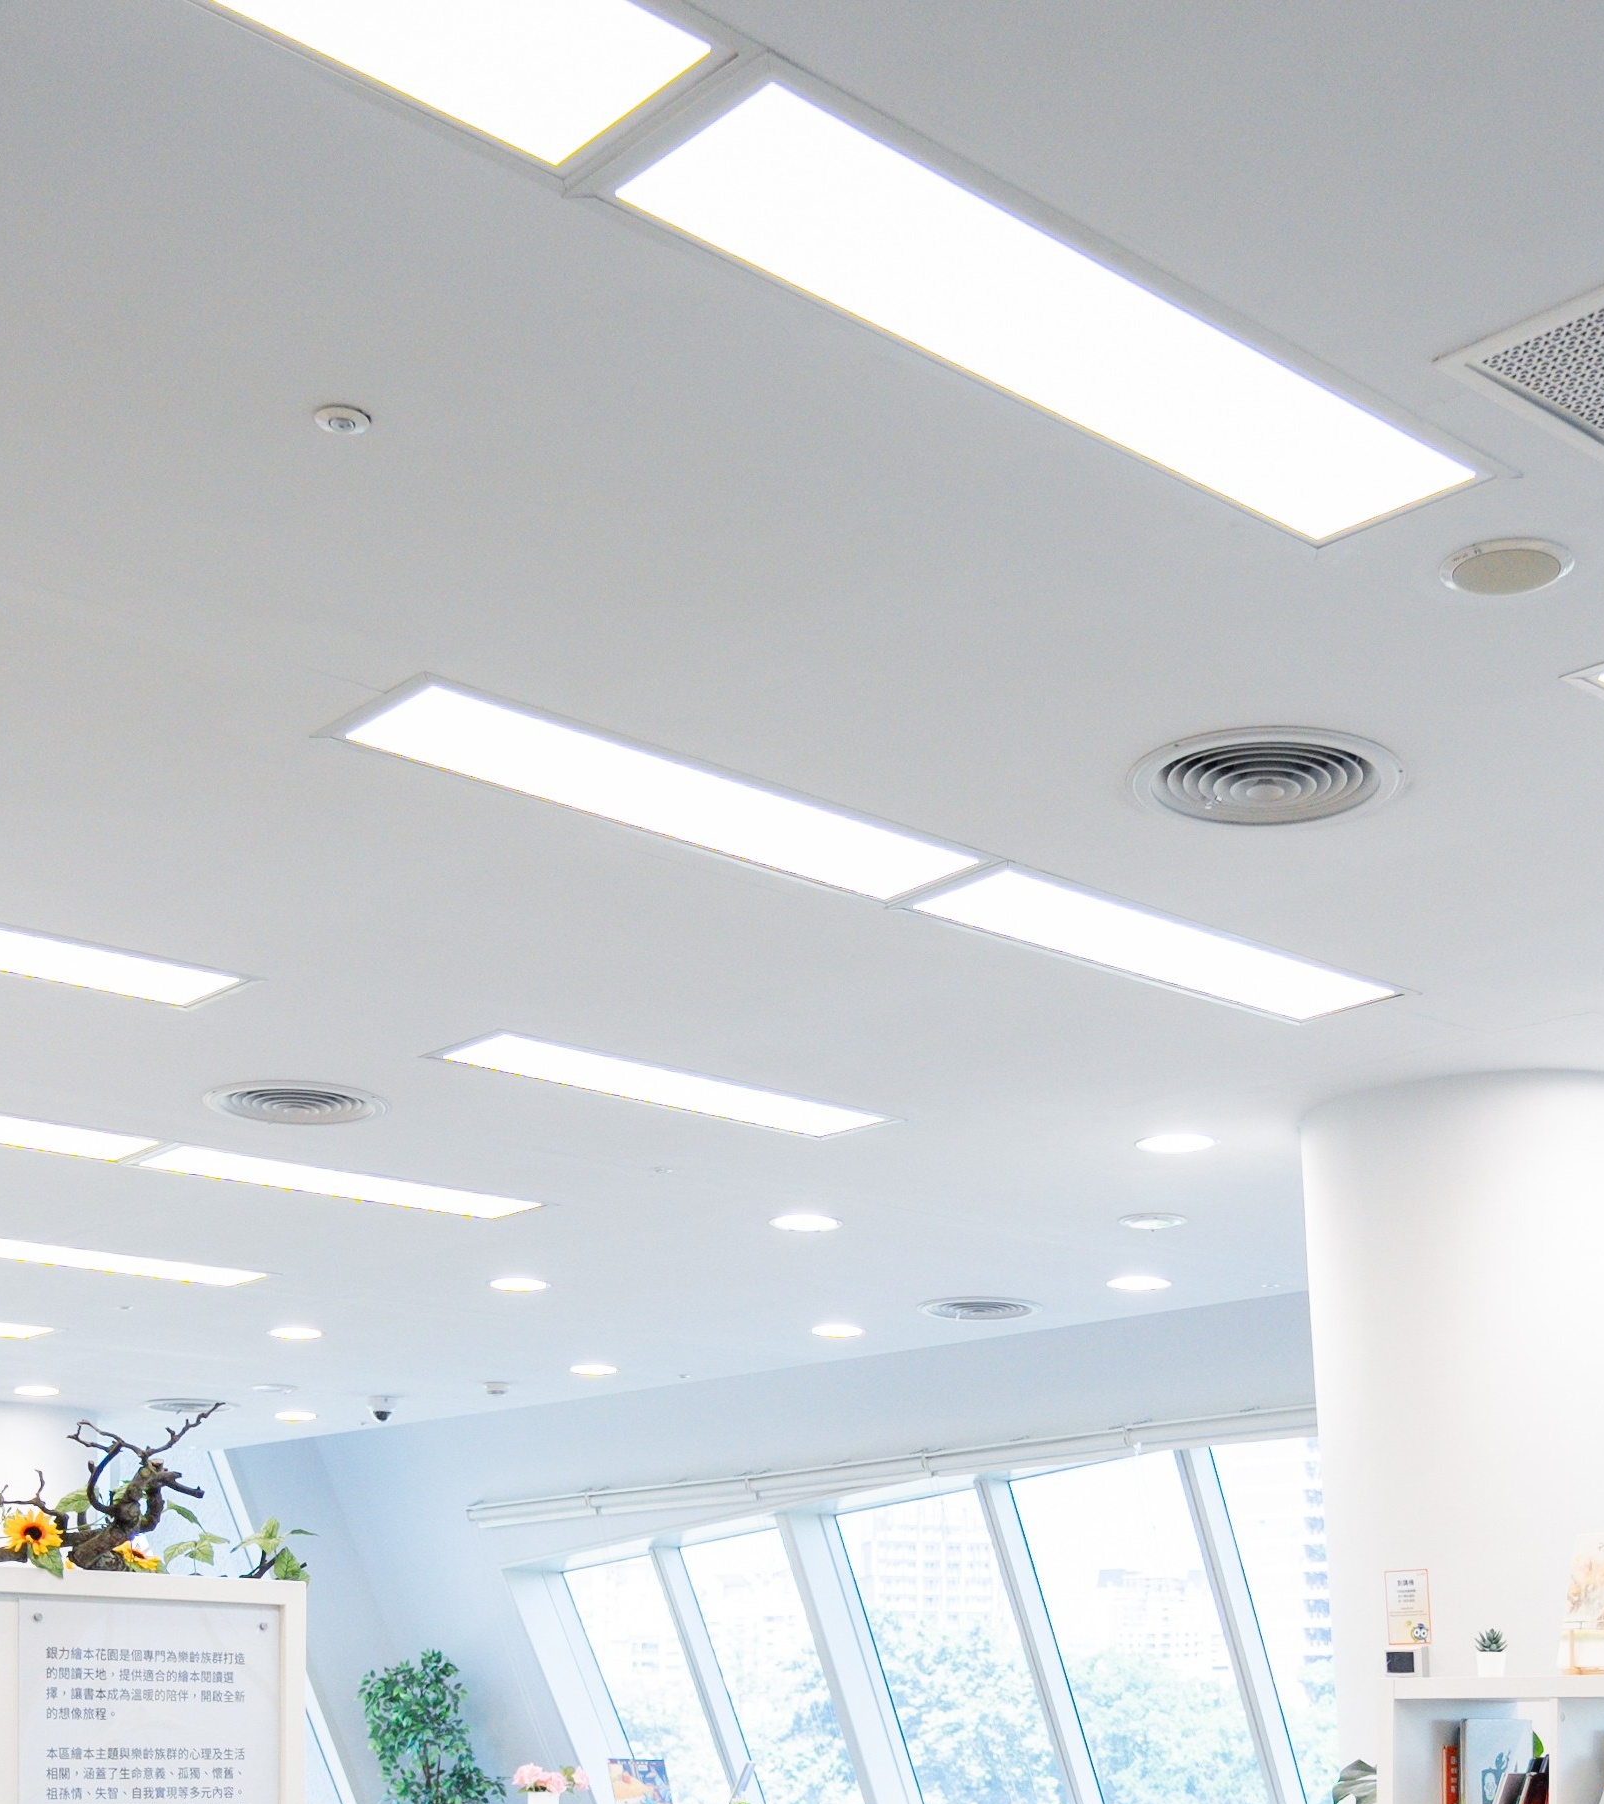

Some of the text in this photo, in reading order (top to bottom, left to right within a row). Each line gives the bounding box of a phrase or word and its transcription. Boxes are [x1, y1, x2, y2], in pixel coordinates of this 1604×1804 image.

[46, 1647, 245, 1665] 銀力繪本花園是個專門為樂齡族群打造
[46, 1707, 116, 1721] 的想像旅程。
[46, 1747, 245, 1761] 本區繪本主題與樂齡族群的心理及生活
